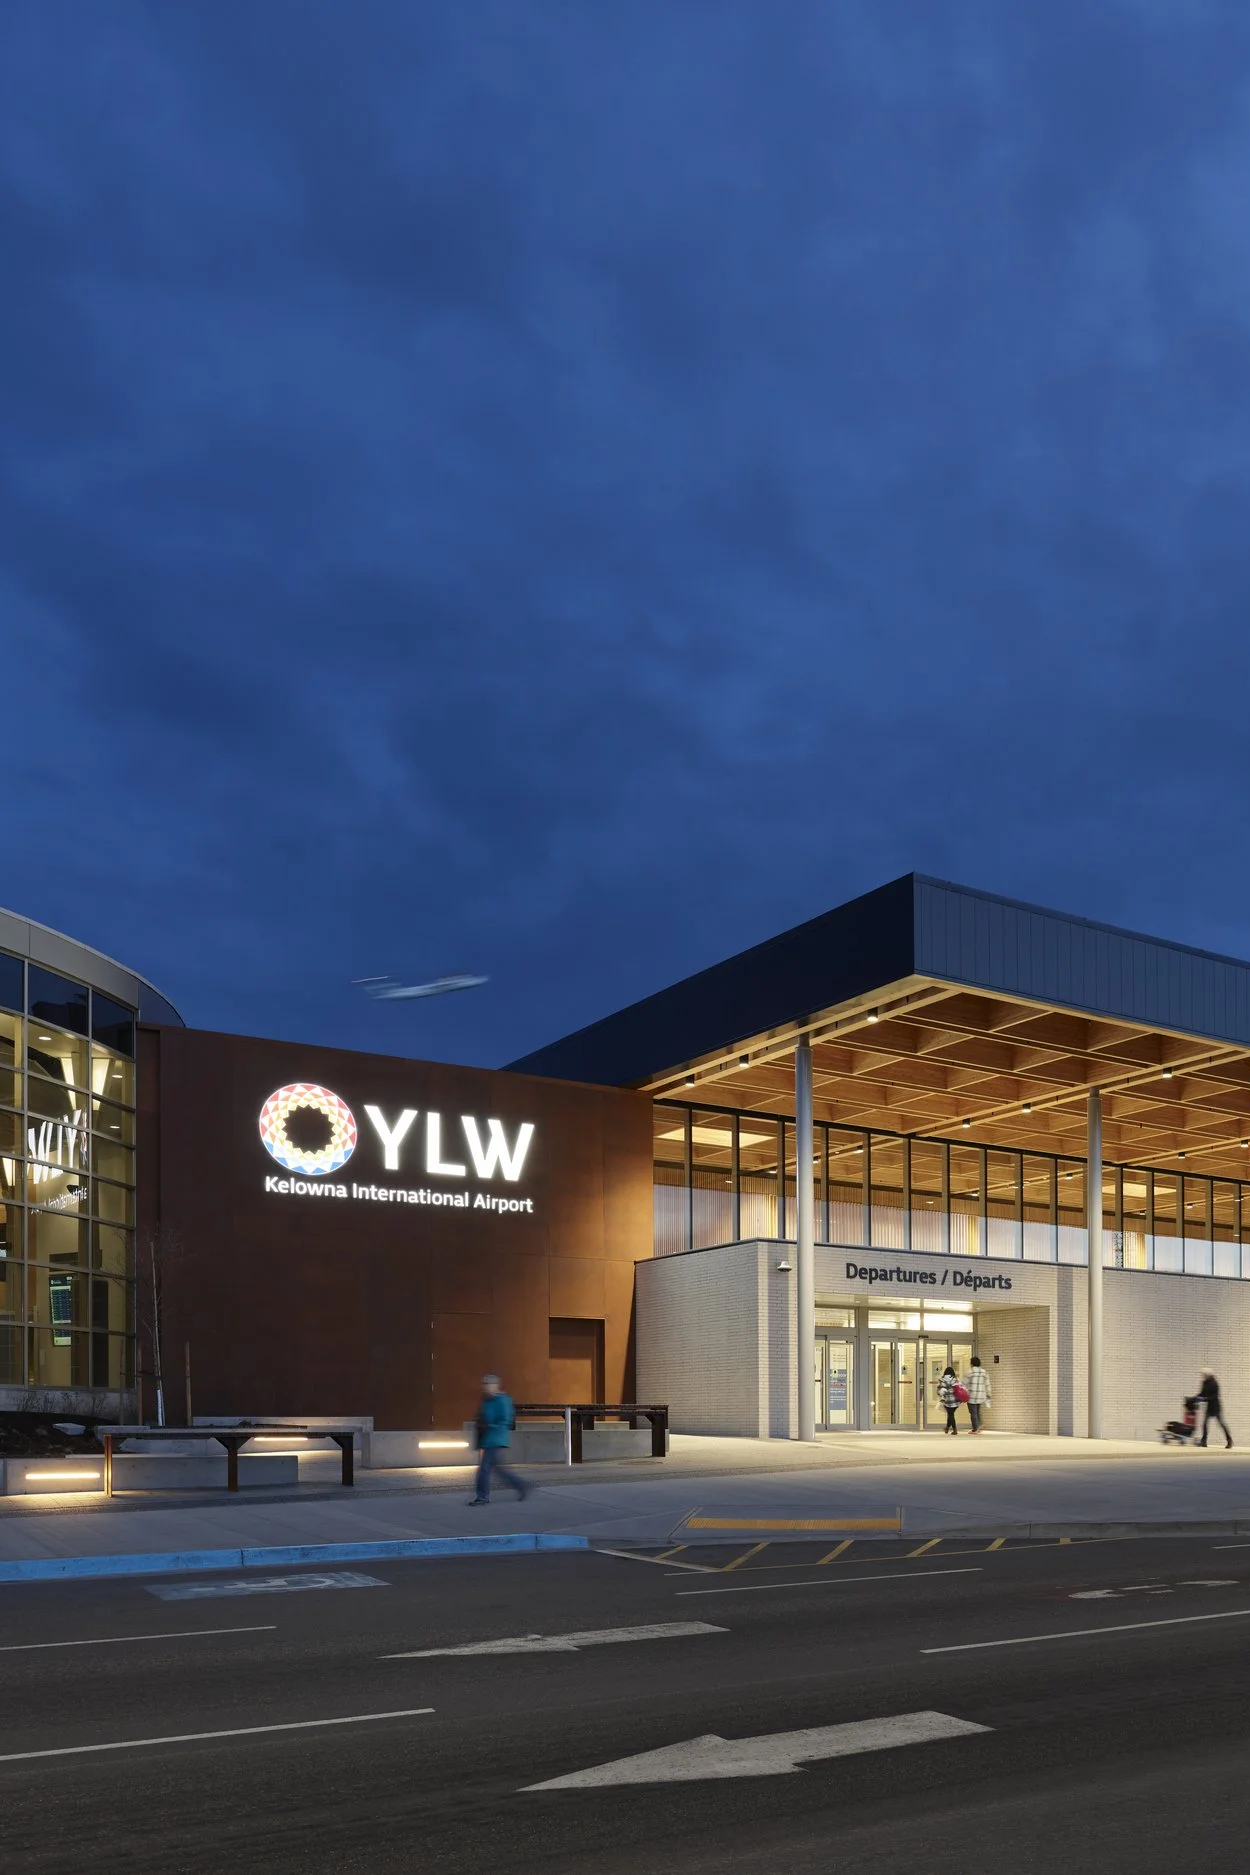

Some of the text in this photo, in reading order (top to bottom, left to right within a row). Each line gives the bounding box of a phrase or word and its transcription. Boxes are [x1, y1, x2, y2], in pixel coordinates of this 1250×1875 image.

[363, 1104, 535, 1181] YLW
[265, 1176, 533, 1213] Kelowna International Airport
[846, 1263, 1012, 1291] Departures / Départs
